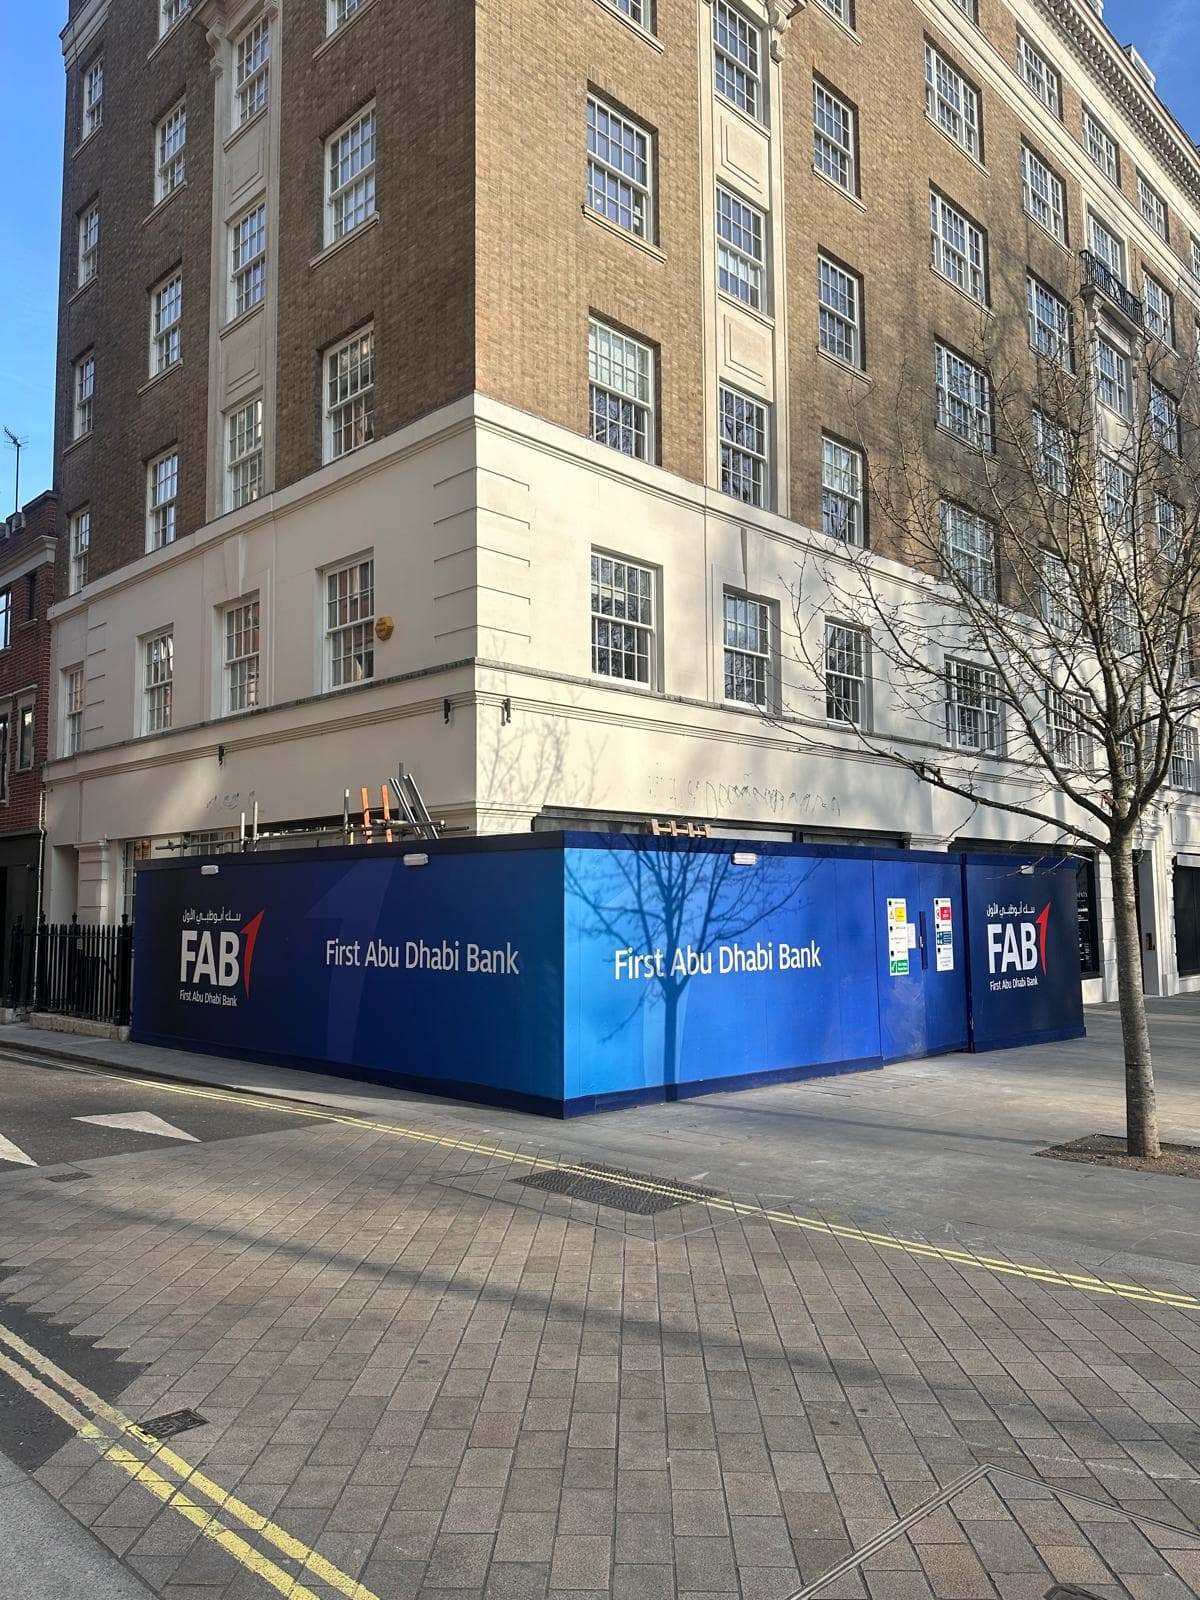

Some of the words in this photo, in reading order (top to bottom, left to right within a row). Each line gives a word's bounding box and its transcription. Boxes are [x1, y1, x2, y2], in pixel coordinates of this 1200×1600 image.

[180, 930, 240, 986] FAB
[326, 938, 360, 966] First
[364, 939, 399, 968] Abu
[405, 940, 460, 972] Dhabi
[466, 942, 520, 974] Bank
[615, 947, 664, 980] First
[670, 945, 712, 976] Abu
[719, 942, 772, 974] Dhabi
[779, 940, 822, 970] Bank
[988, 922, 1038, 974] FAB
[180, 990, 192, 1002] First
[192, 991, 204, 1003] Abu
[204, 992, 222, 1005] Dhabi
[222, 994, 238, 1006] Bank
[990, 980, 1001, 991] First
[1002, 980, 1012, 990] Abu
[1012, 977, 1026, 988] Dhabi
[1027, 976, 1038, 986] Bank
